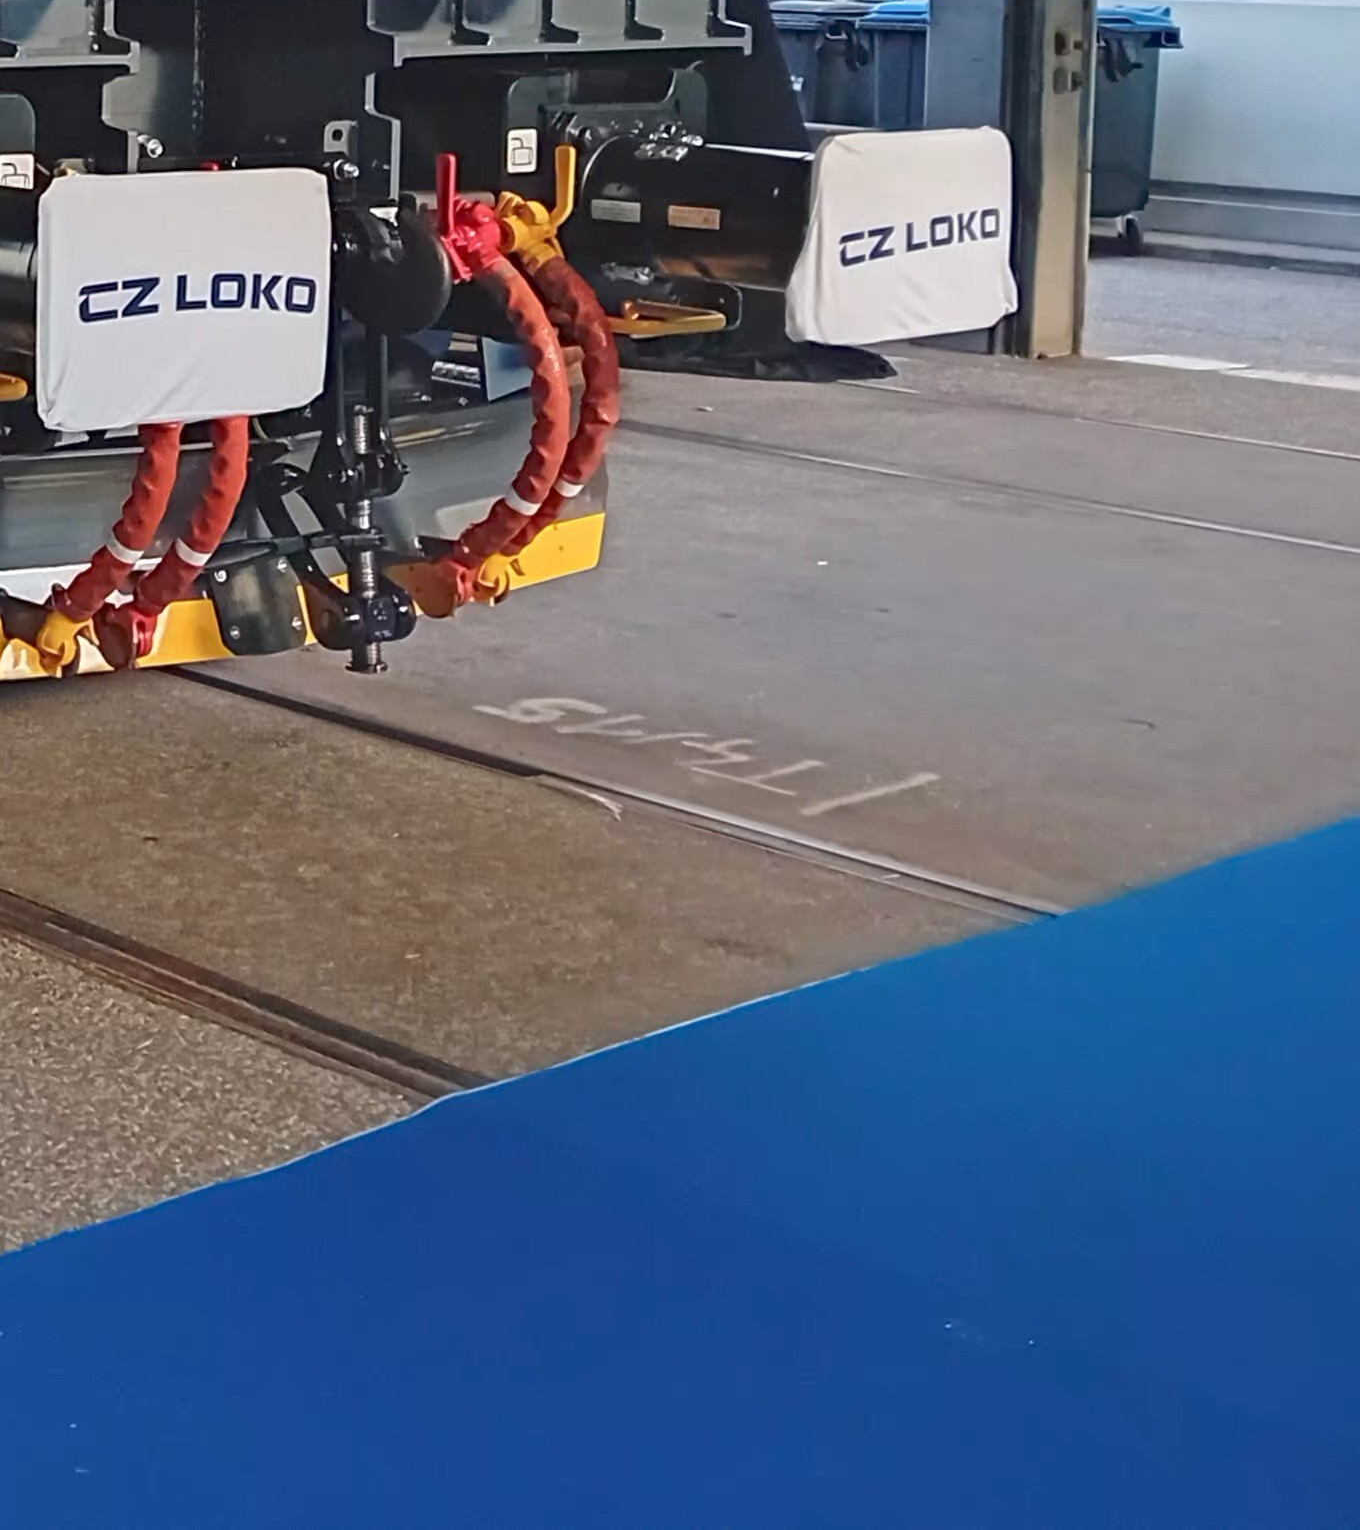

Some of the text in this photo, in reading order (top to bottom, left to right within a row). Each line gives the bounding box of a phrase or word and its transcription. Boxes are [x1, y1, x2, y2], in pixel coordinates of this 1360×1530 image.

[838, 208, 1000, 268] CZ LOKO
[78, 272, 317, 324] CZ LOKO
